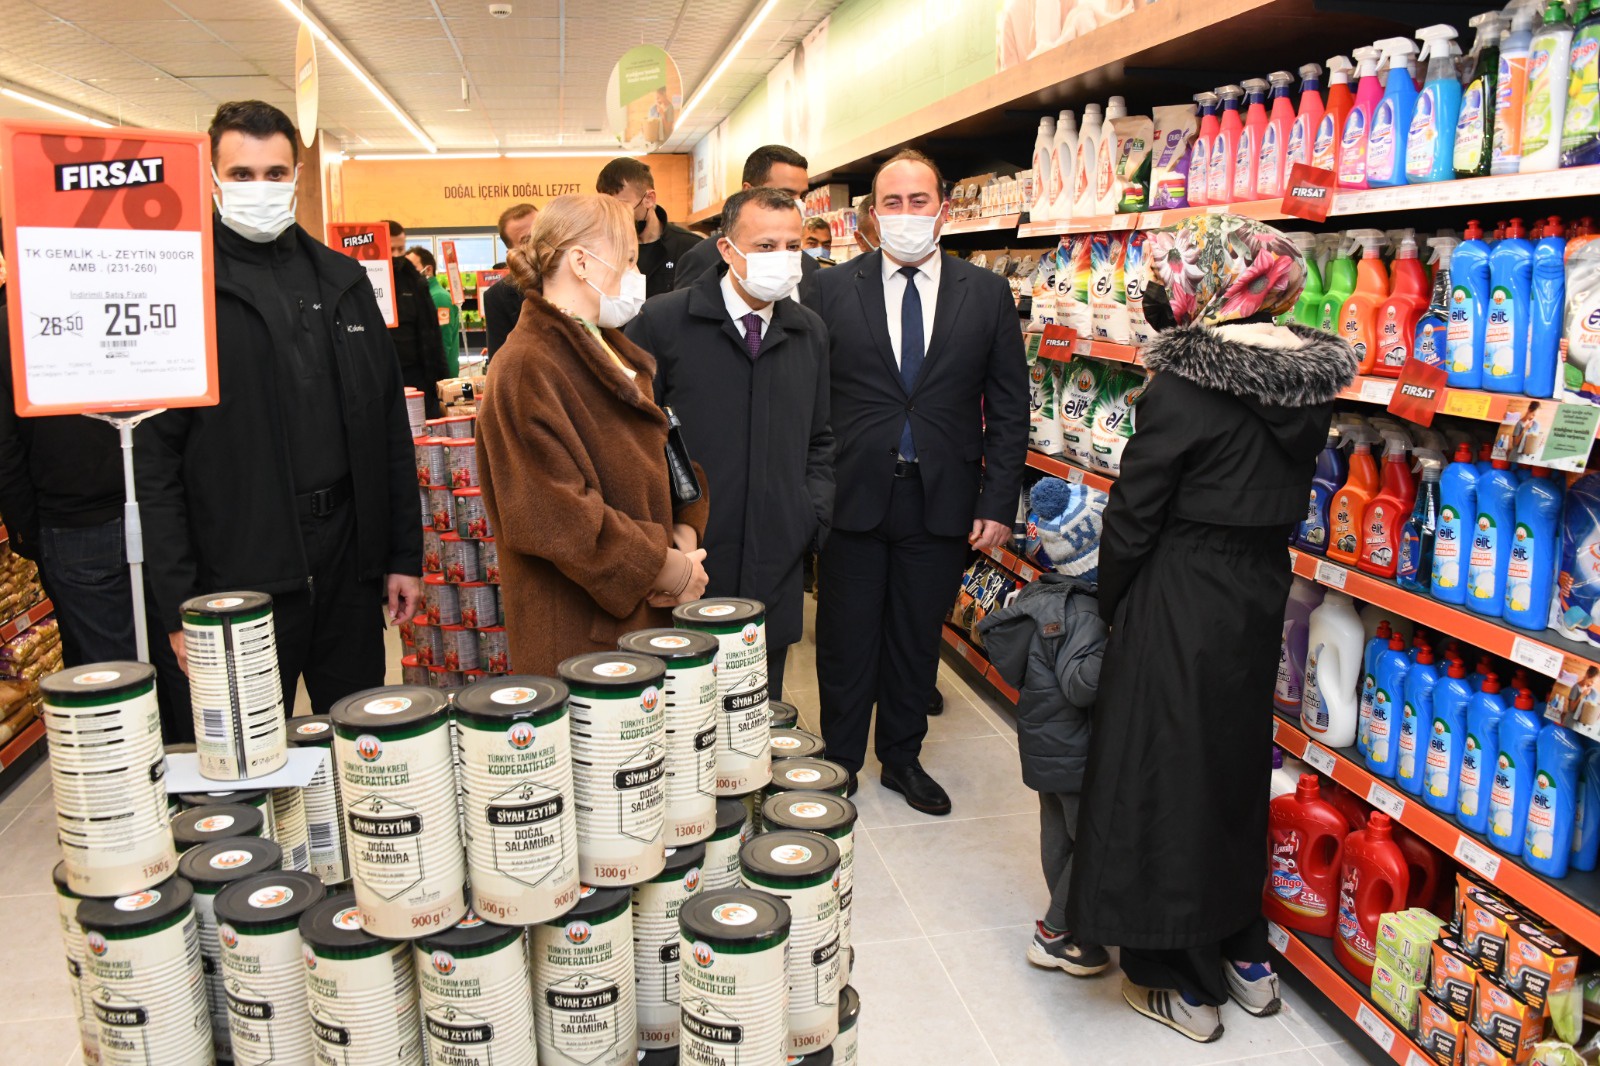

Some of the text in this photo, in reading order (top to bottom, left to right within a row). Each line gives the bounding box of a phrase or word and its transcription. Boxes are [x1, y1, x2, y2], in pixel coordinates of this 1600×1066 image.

[62, 158, 162, 190] FIRSAT
[444, 184, 476, 198] DOĞAL
[478, 183, 510, 200] İÇERİK
[512, 183, 544, 198] DOĞAL
[1292, 188, 1326, 198] FIRSAT
[344, 233, 374, 248] FIRSAT
[25, 249, 41, 258] TK
[46, 248, 93, 259] GEMLİK
[116, 249, 156, 260] ZEYTİN
[160, 250, 194, 260] 900GR
[70, 263, 157, 275] AMB (231-260)
[104, 303, 176, 336] 25,50
[1452, 310, 1469, 321] elit
[1492, 312, 1509, 322] elit
[1384, 324, 1398, 334] elit
[1046, 338, 1070, 347] FIRSAT
[1401, 384, 1435, 399] FIRSAT
[1440, 527, 1456, 540] elit
[1476, 538, 1492, 550] elit
[1513, 548, 1529, 560] elit
[732, 698, 752, 708] SİYAH
[1374, 708, 1388, 720] elit
[620, 720, 644, 730] TÜRKİYE
[1432, 740, 1446, 752] elit
[488, 746, 556, 764] TÜRKİYE TARIM KREDİ
[364, 766, 386, 774] TARIM
[387, 762, 408, 773] KREDİ
[488, 756, 557, 774] KOOPERATİFLERİ
[345, 773, 410, 787] KOOPERATİFLERİ
[626, 770, 650, 786] SİYAH
[1496, 774, 1510, 789] elit
[640, 788, 659, 800] DOĞAL
[1534, 794, 1551, 809] elit
[497, 804, 558, 823] SİYAH ZEYTİN
[354, 818, 412, 835] SİYAH ZEYTİN
[514, 826, 545, 840] DOĞAL
[674, 825, 696, 838] 1300
[368, 840, 396, 852] DOĞAL
[505, 834, 555, 852] SALAMURA
[361, 852, 410, 864] SALAMURA
[143, 865, 162, 879] 1300
[594, 866, 626, 880] 1300 g
[1273, 876, 1302, 888] Bingo
[478, 898, 498, 914] 1300
[554, 894, 568, 908] 900
[412, 914, 440, 928] 900 g
[1382, 924, 1396, 940] Ernet
[573, 946, 593, 954] TARIM
[594, 941, 612, 952] KREDİ
[1519, 942, 1537, 959] Ernet
[112, 960, 132, 968] KREDİ
[241, 954, 260, 964] KREDİ
[548, 950, 612, 966] KOOPERATİFLERİ
[698, 971, 714, 982] TARIM
[716, 975, 736, 984] KREDİ
[1376, 968, 1392, 984] Ernet
[438, 978, 480, 988] TARIM KREDİ
[555, 992, 612, 1008] SİYAH ZEYTİN
[570, 1014, 598, 1024] DOĞAL
[561, 1021, 608, 1034] SALAMURA
[701, 1025, 732, 1041] ZEYTİN
[451, 1028, 483, 1042] ZEYTİN
[640, 1032, 662, 1041] 1300
[691, 1039, 714, 1054] DOĞAL
[793, 1038, 815, 1048] 1300
[441, 1044, 468, 1057] DOĞAL
